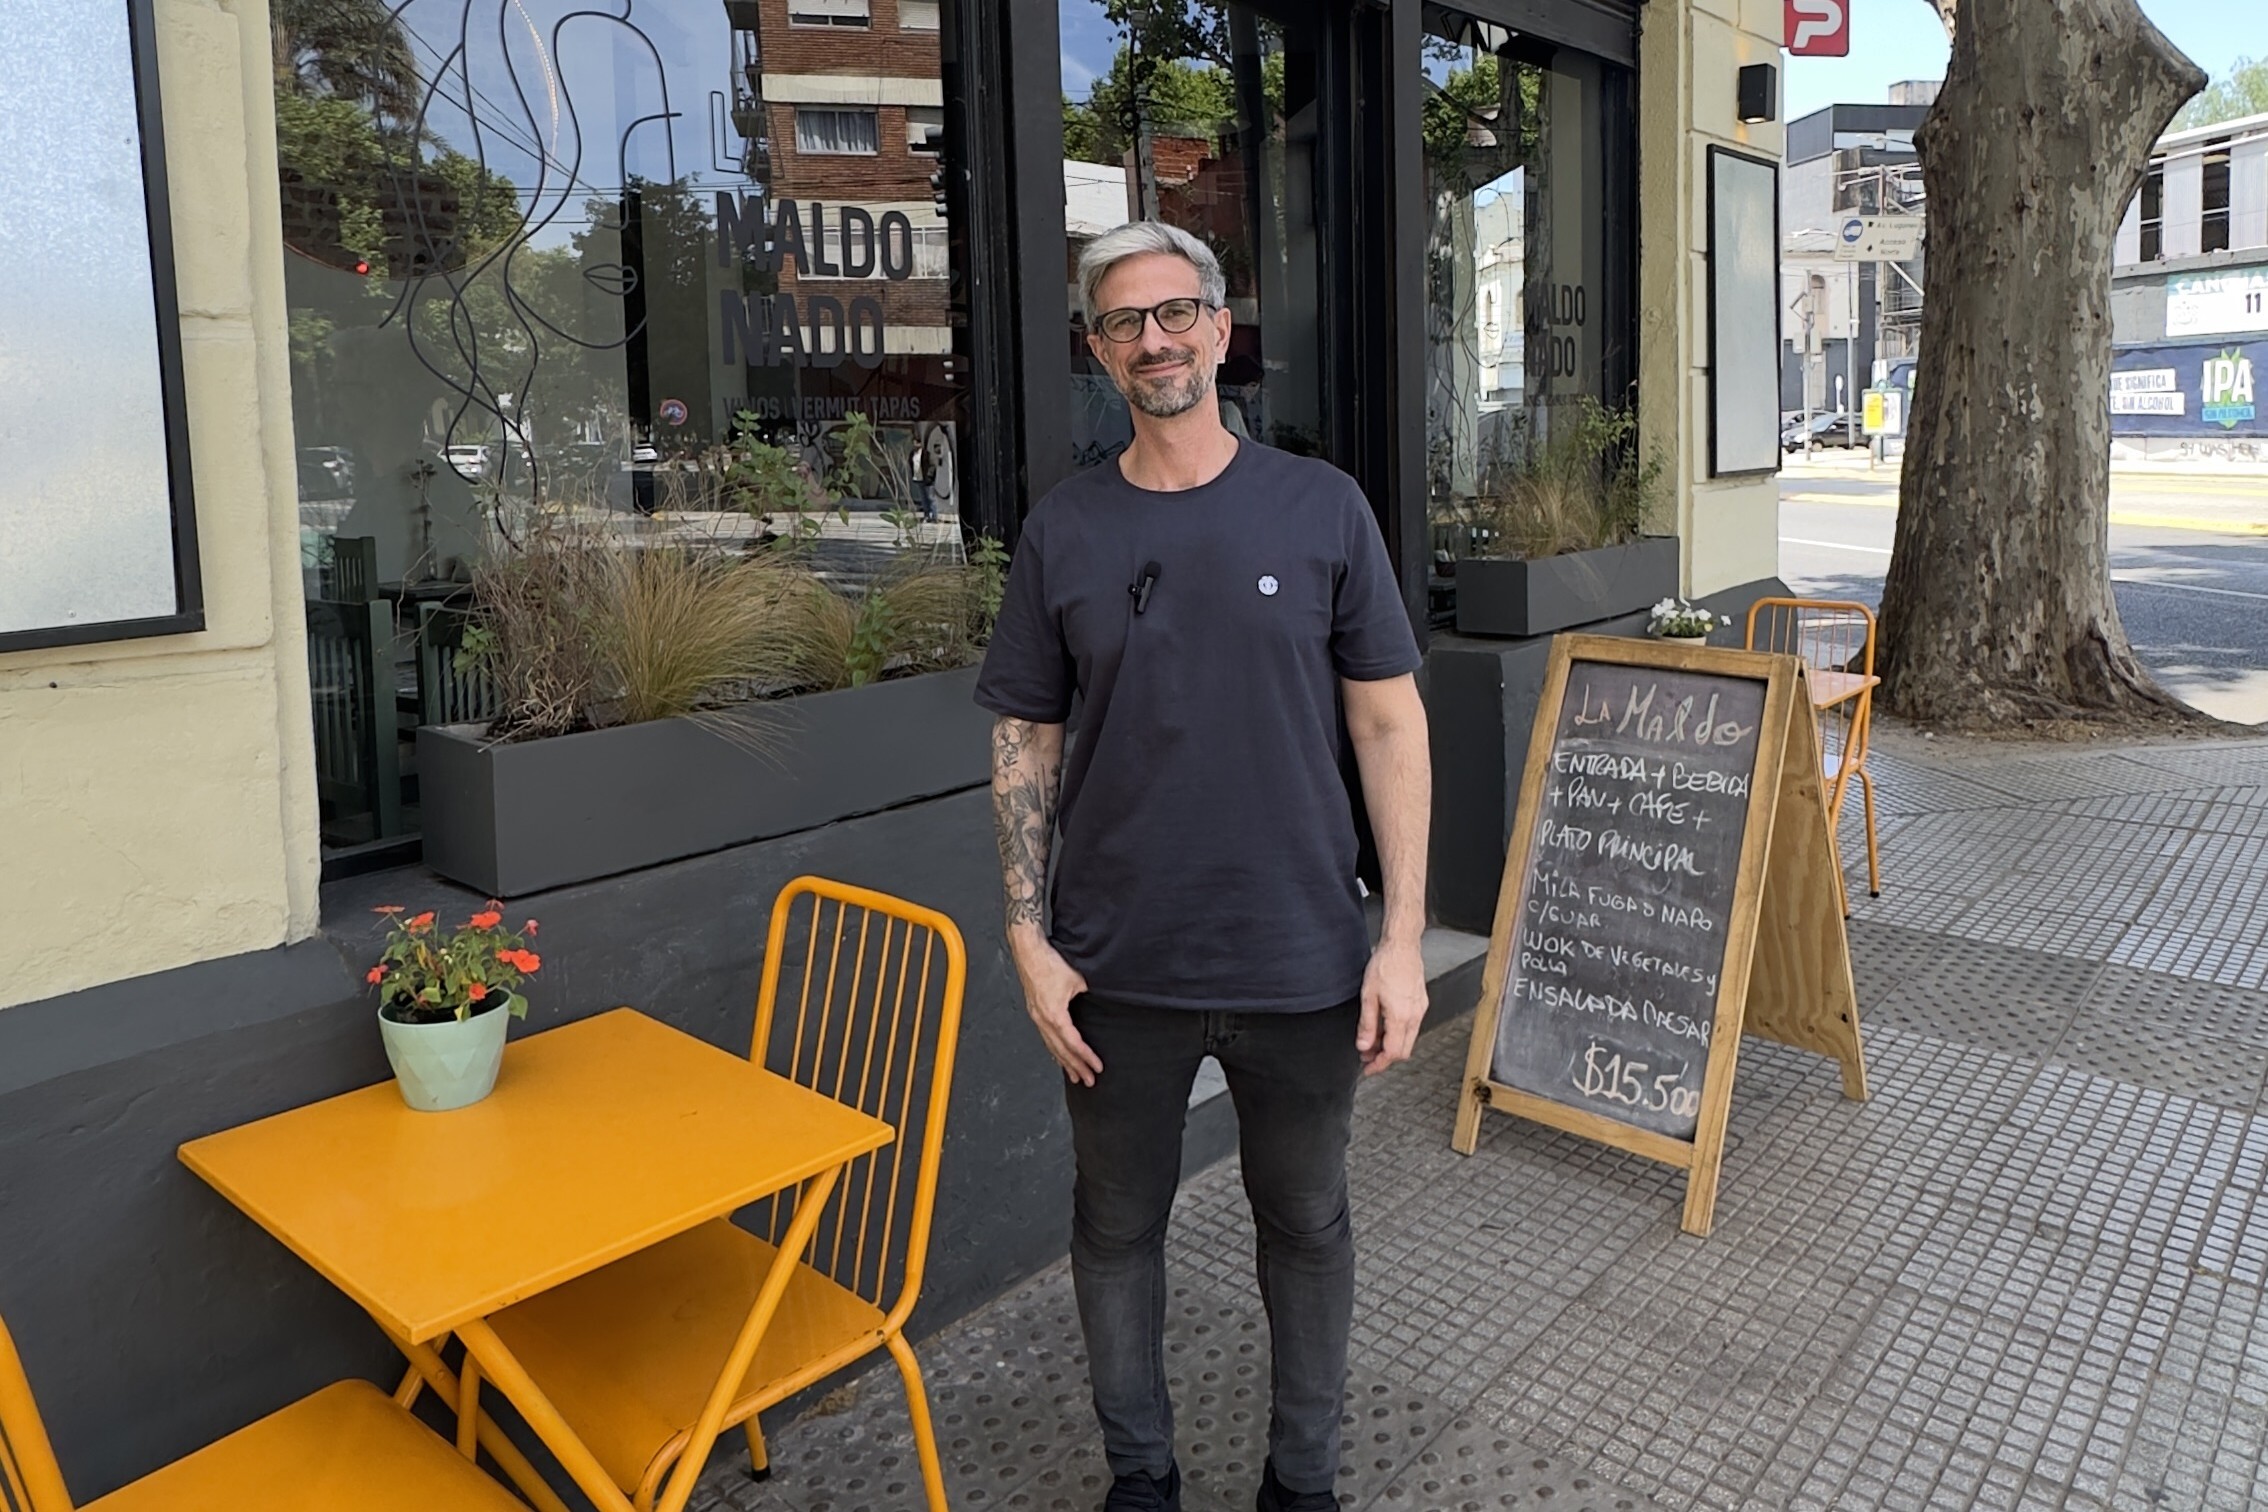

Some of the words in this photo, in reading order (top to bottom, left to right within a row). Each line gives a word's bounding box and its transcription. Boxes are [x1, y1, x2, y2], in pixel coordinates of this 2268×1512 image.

[715, 190, 914, 281] MALDO
[720, 289, 885, 369] NADO
[2125, 374, 2167, 390] SIGNIFICA
[2202, 359, 2255, 403] IPA
[792, 396, 860, 419] VERMUT
[870, 396, 921, 419] TAPAS
[2137, 395, 2174, 411] ALCOHOL
[1555, 752, 1647, 782] ENTRADA
[1672, 762, 1750, 799] BEBIDA
[1568, 776, 1606, 808] PAN
[1539, 819, 1592, 851] PLATO
[1523, 927, 1575, 958] WOK
[1581, 940, 1605, 959] DE
[1513, 978, 1638, 1021] ENSALADA
[1572, 1041, 1700, 1117] $15.500
